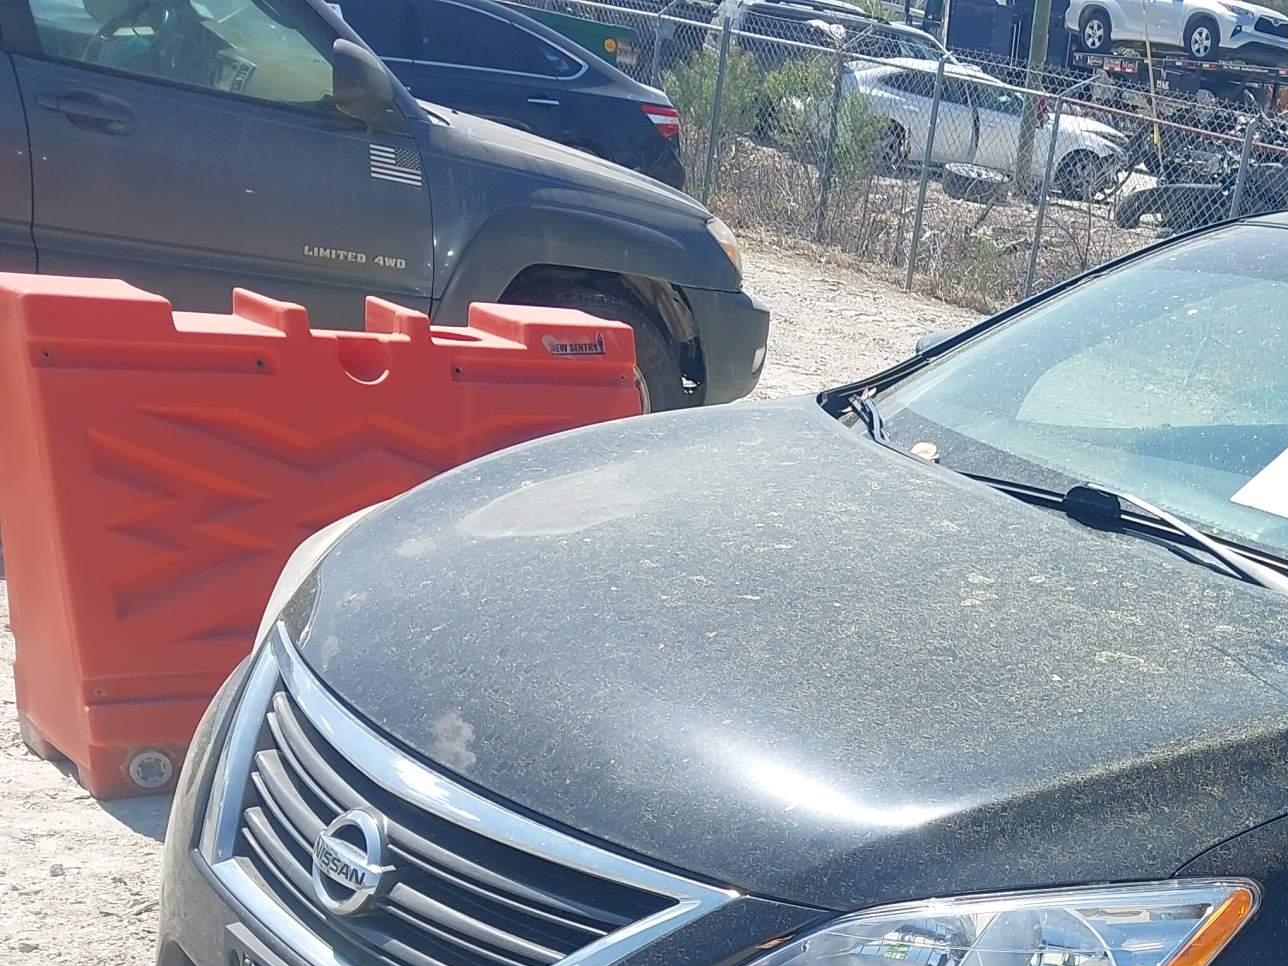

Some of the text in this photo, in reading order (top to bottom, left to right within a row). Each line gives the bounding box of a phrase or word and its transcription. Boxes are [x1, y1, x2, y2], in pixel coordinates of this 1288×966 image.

[303, 245, 406, 269] LIMITED 4WD
[313, 839, 366, 886] NISSAN
